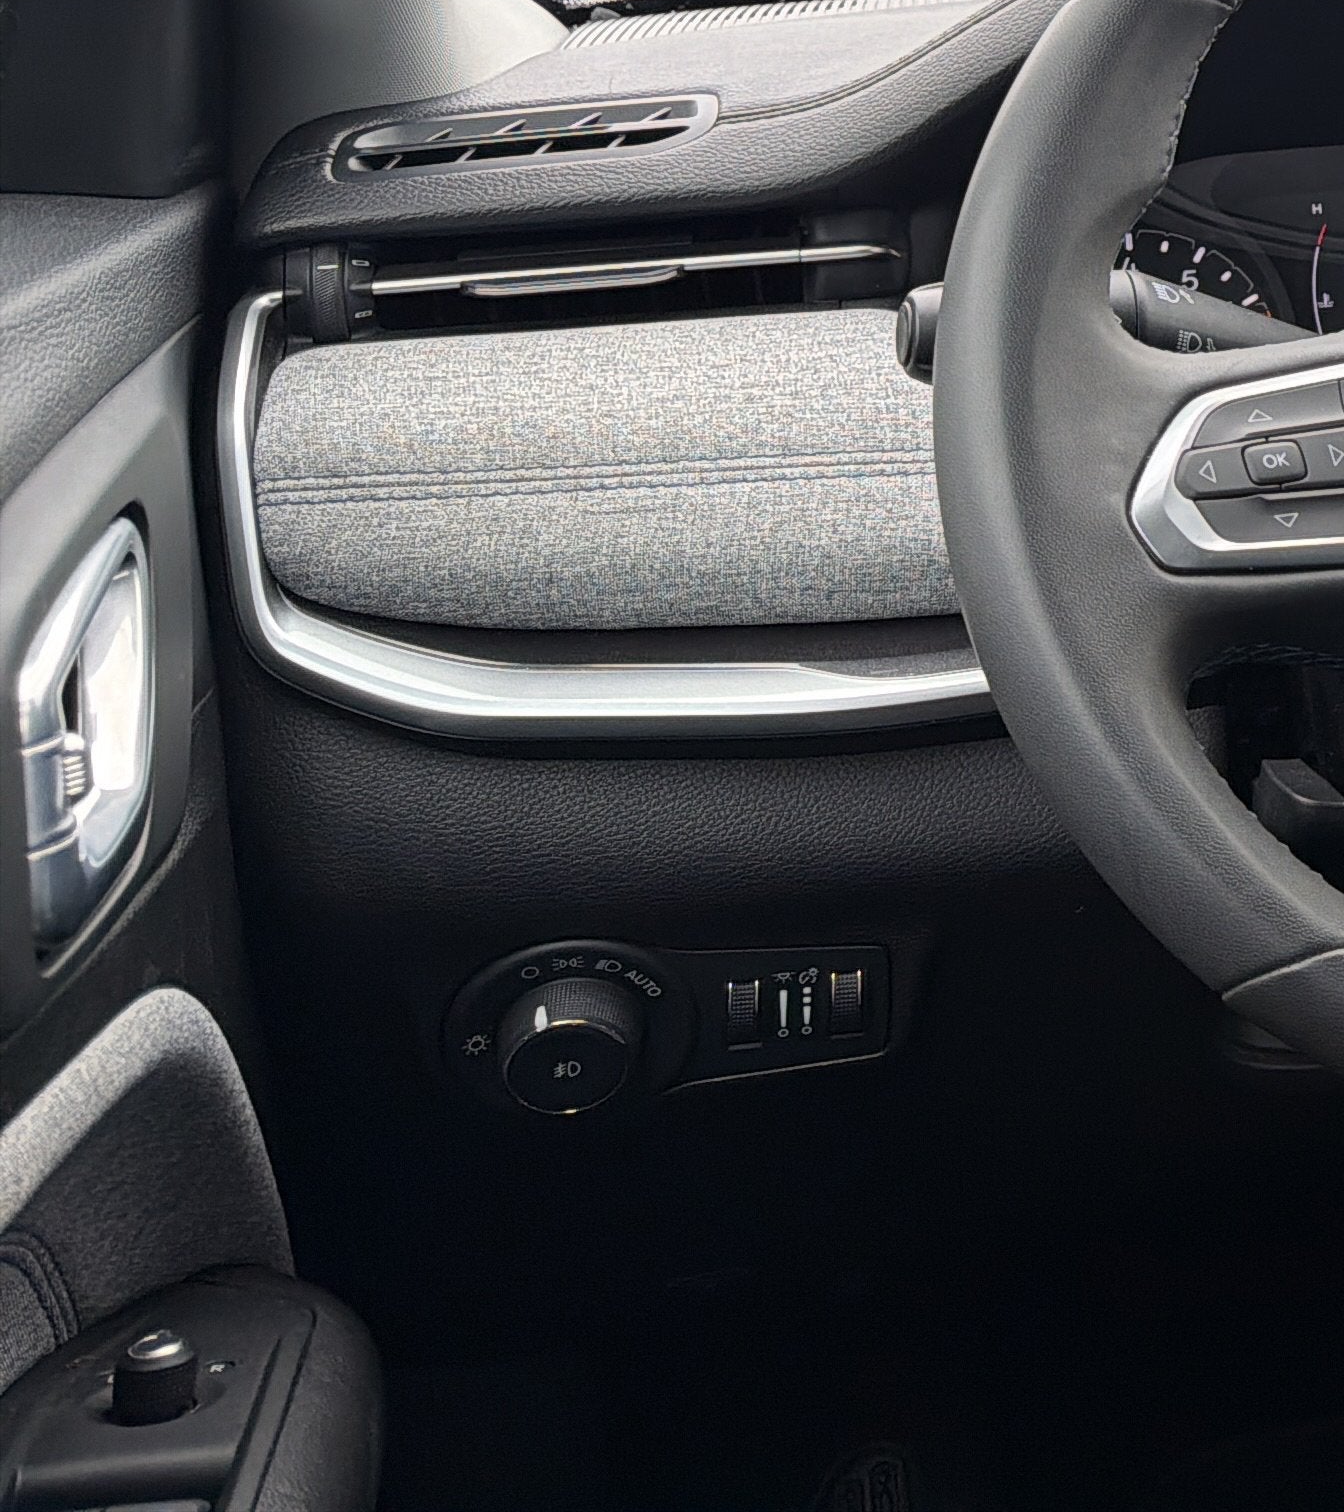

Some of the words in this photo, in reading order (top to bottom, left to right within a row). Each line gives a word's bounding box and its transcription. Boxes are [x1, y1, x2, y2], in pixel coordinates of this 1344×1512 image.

[1311, 203, 1323, 215] H
[1181, 268, 1200, 290] 5
[1262, 449, 1290, 469] OK
[624, 967, 662, 998] AUTO
